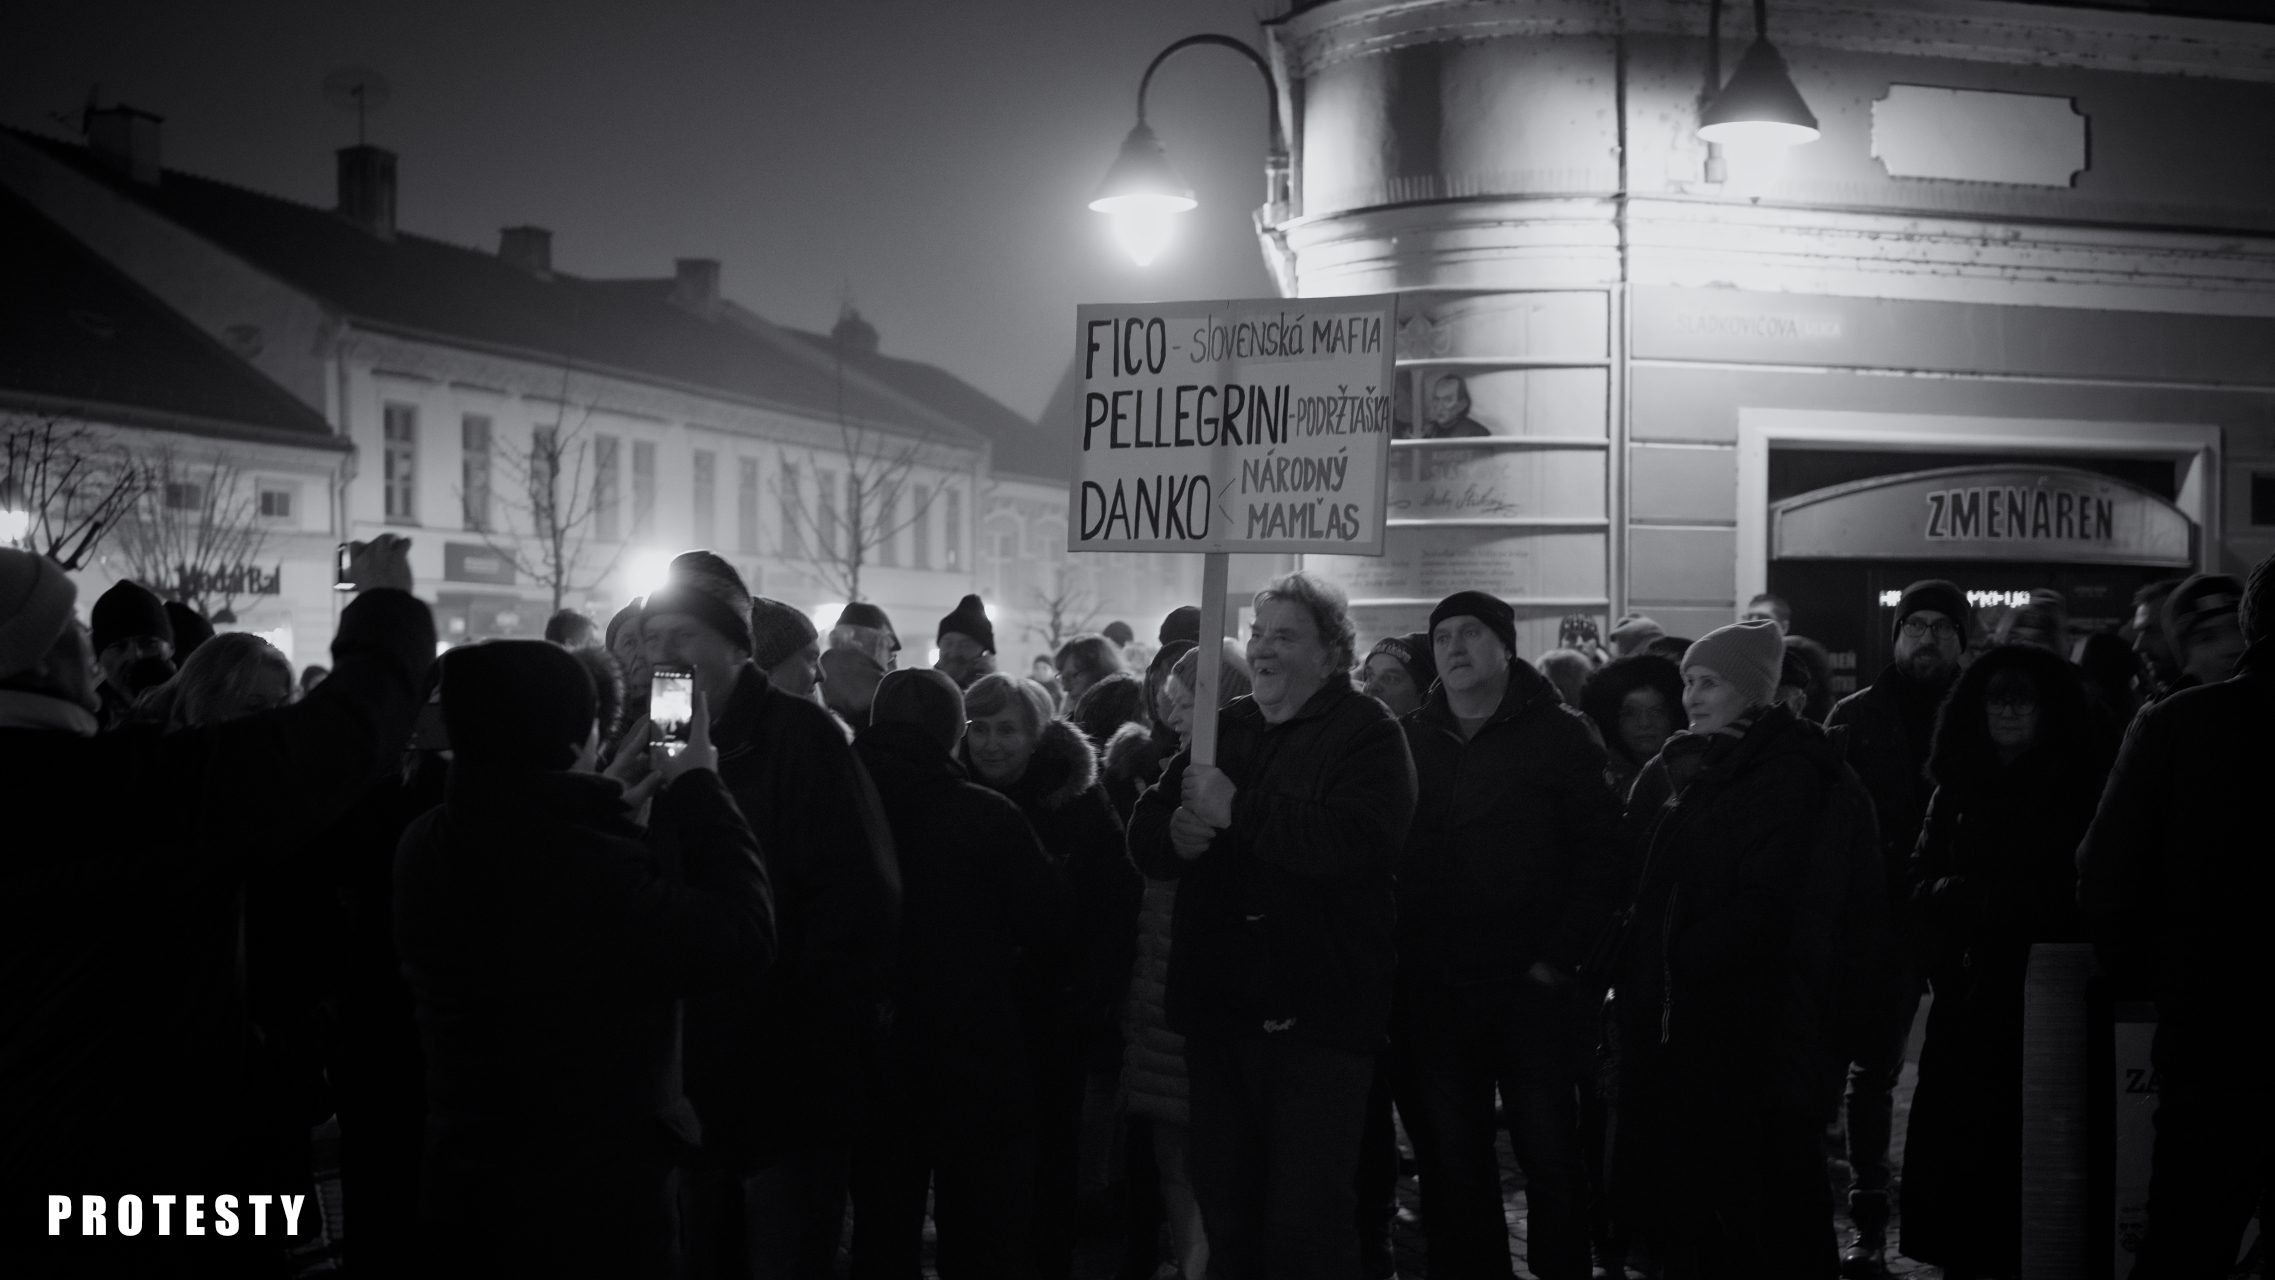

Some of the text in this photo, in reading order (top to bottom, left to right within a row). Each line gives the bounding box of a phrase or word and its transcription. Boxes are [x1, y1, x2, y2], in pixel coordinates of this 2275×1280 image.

[1085, 317, 1167, 379] FICO
[1311, 317, 1380, 355] MAFIA
[1242, 447, 1348, 494] NÁRODNÝ
[1081, 474, 1211, 541] DANKO
[1926, 476, 2114, 541] ZMENÁREŇ
